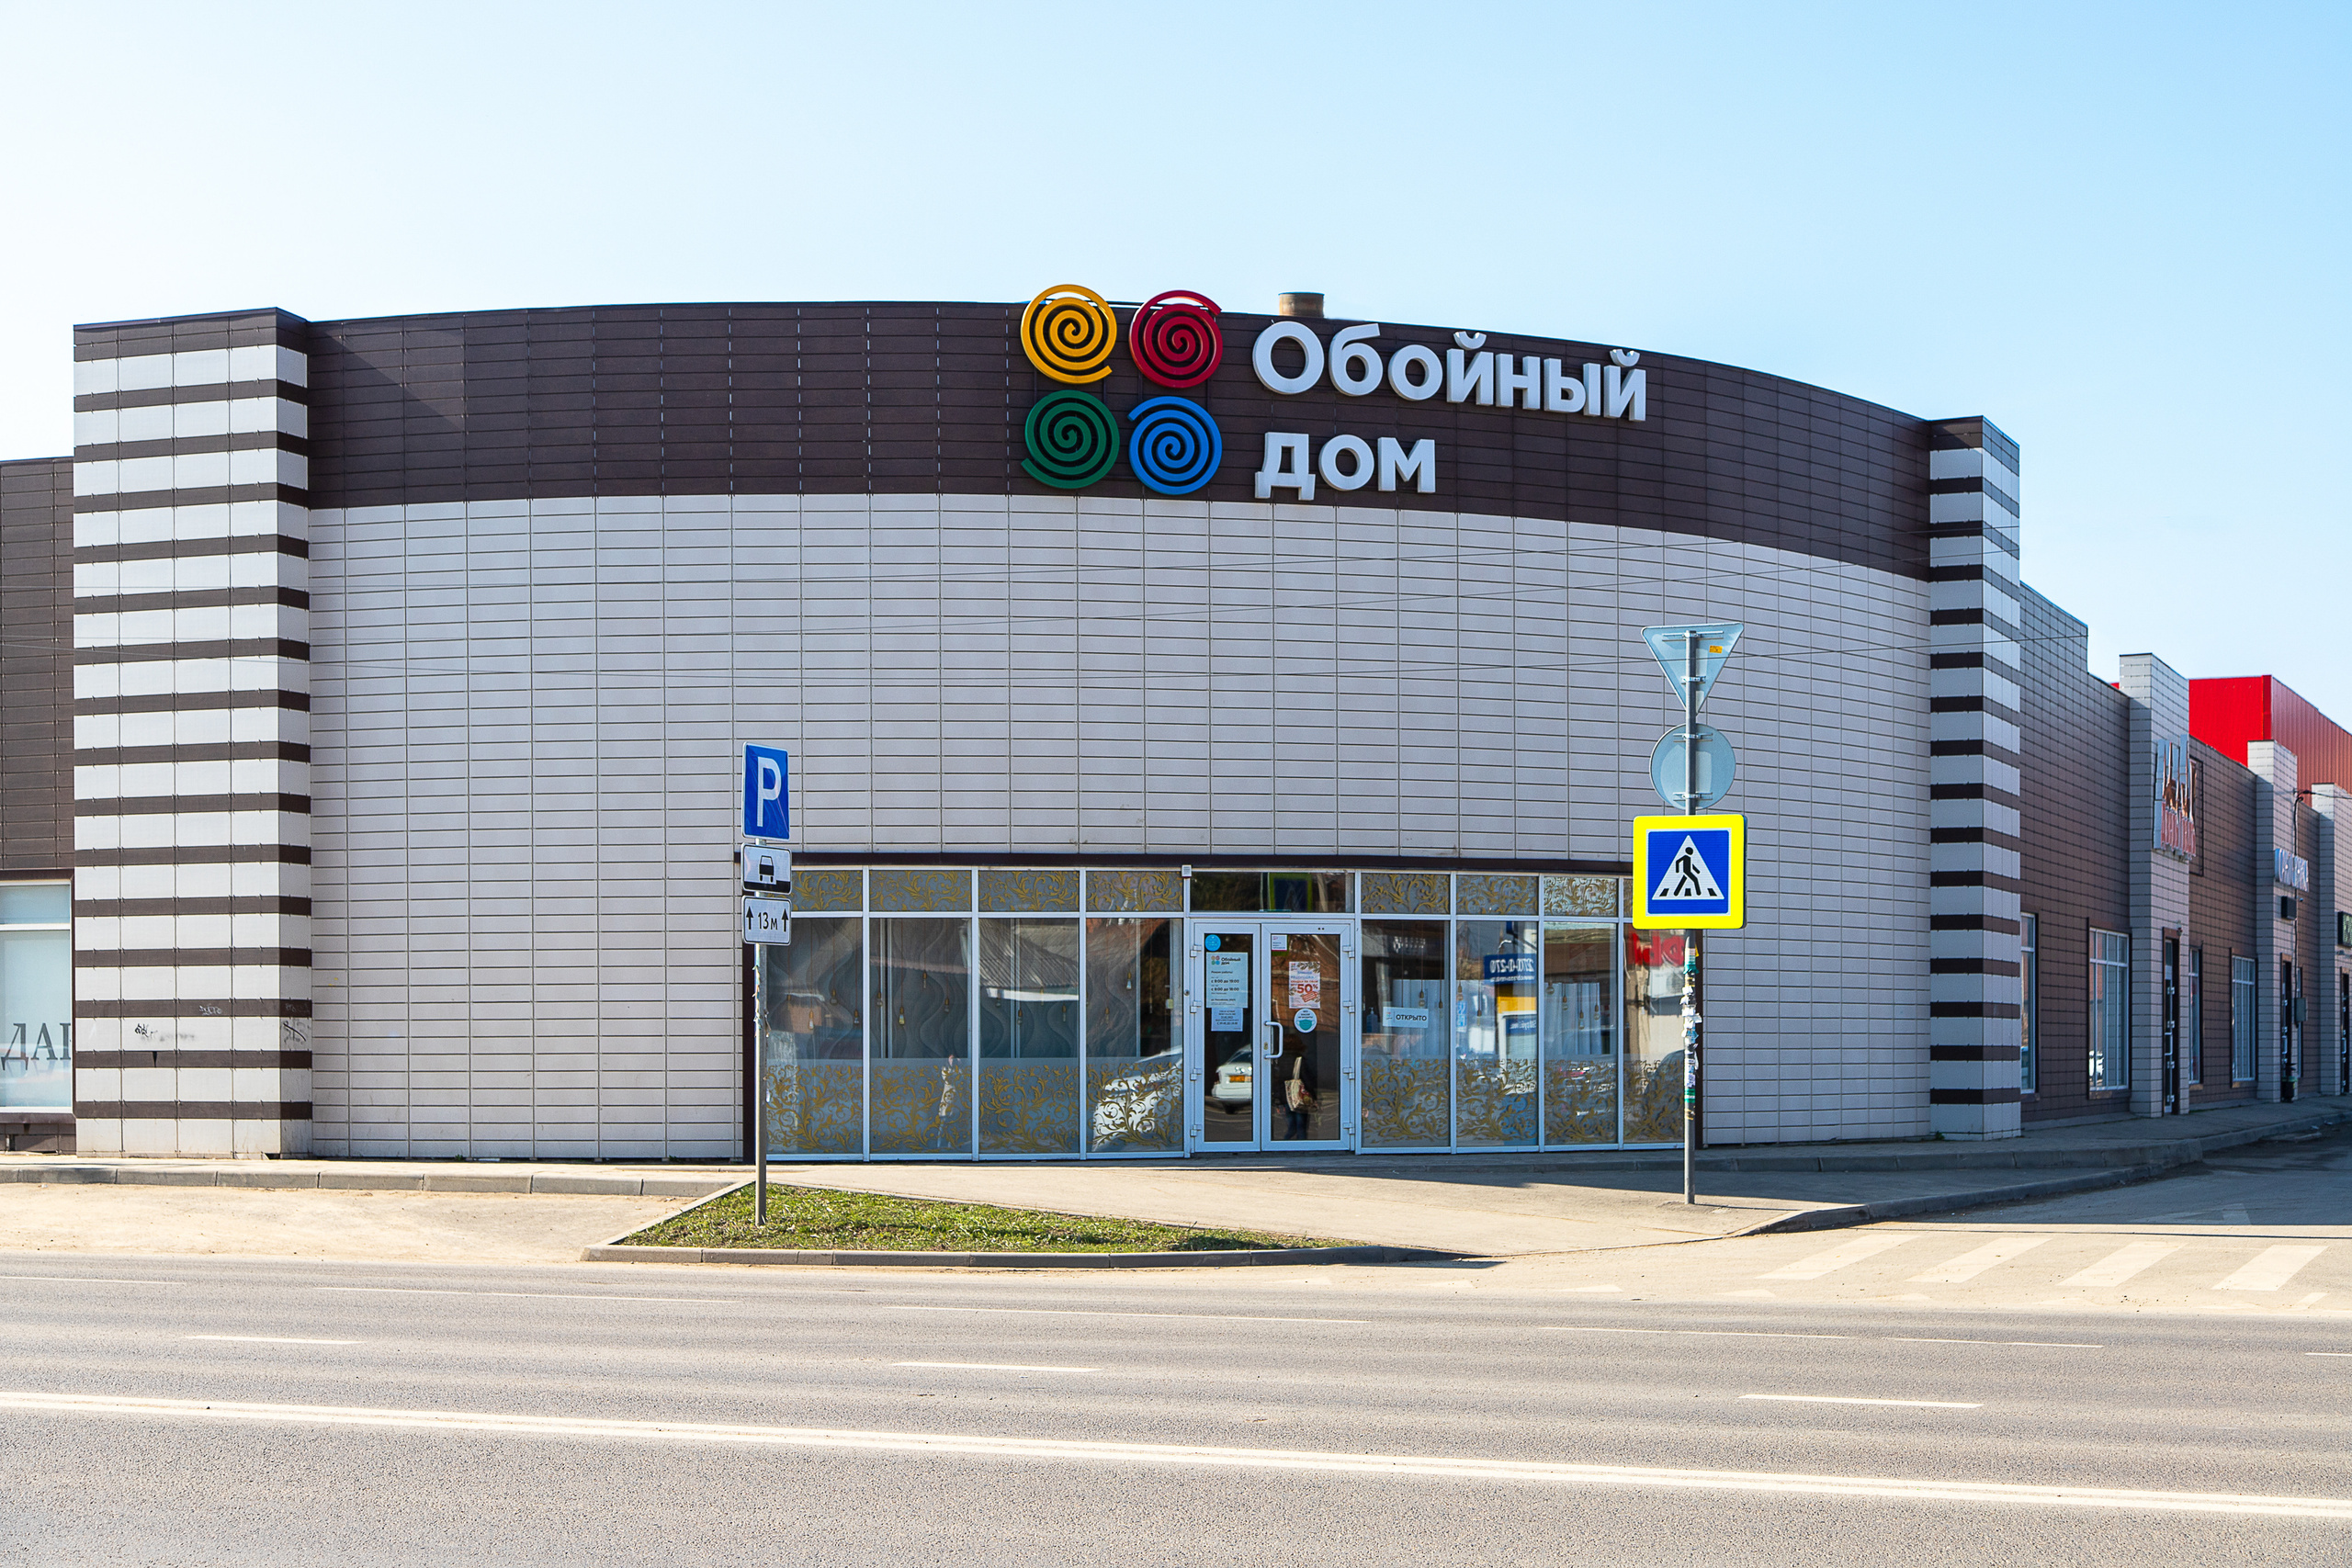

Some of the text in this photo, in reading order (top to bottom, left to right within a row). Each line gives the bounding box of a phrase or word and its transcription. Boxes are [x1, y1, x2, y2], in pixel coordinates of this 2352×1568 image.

[1252, 321, 1646, 422] Обойный
[756, 756, 782, 828] P
[1296, 984, 1318, 994] 50%
